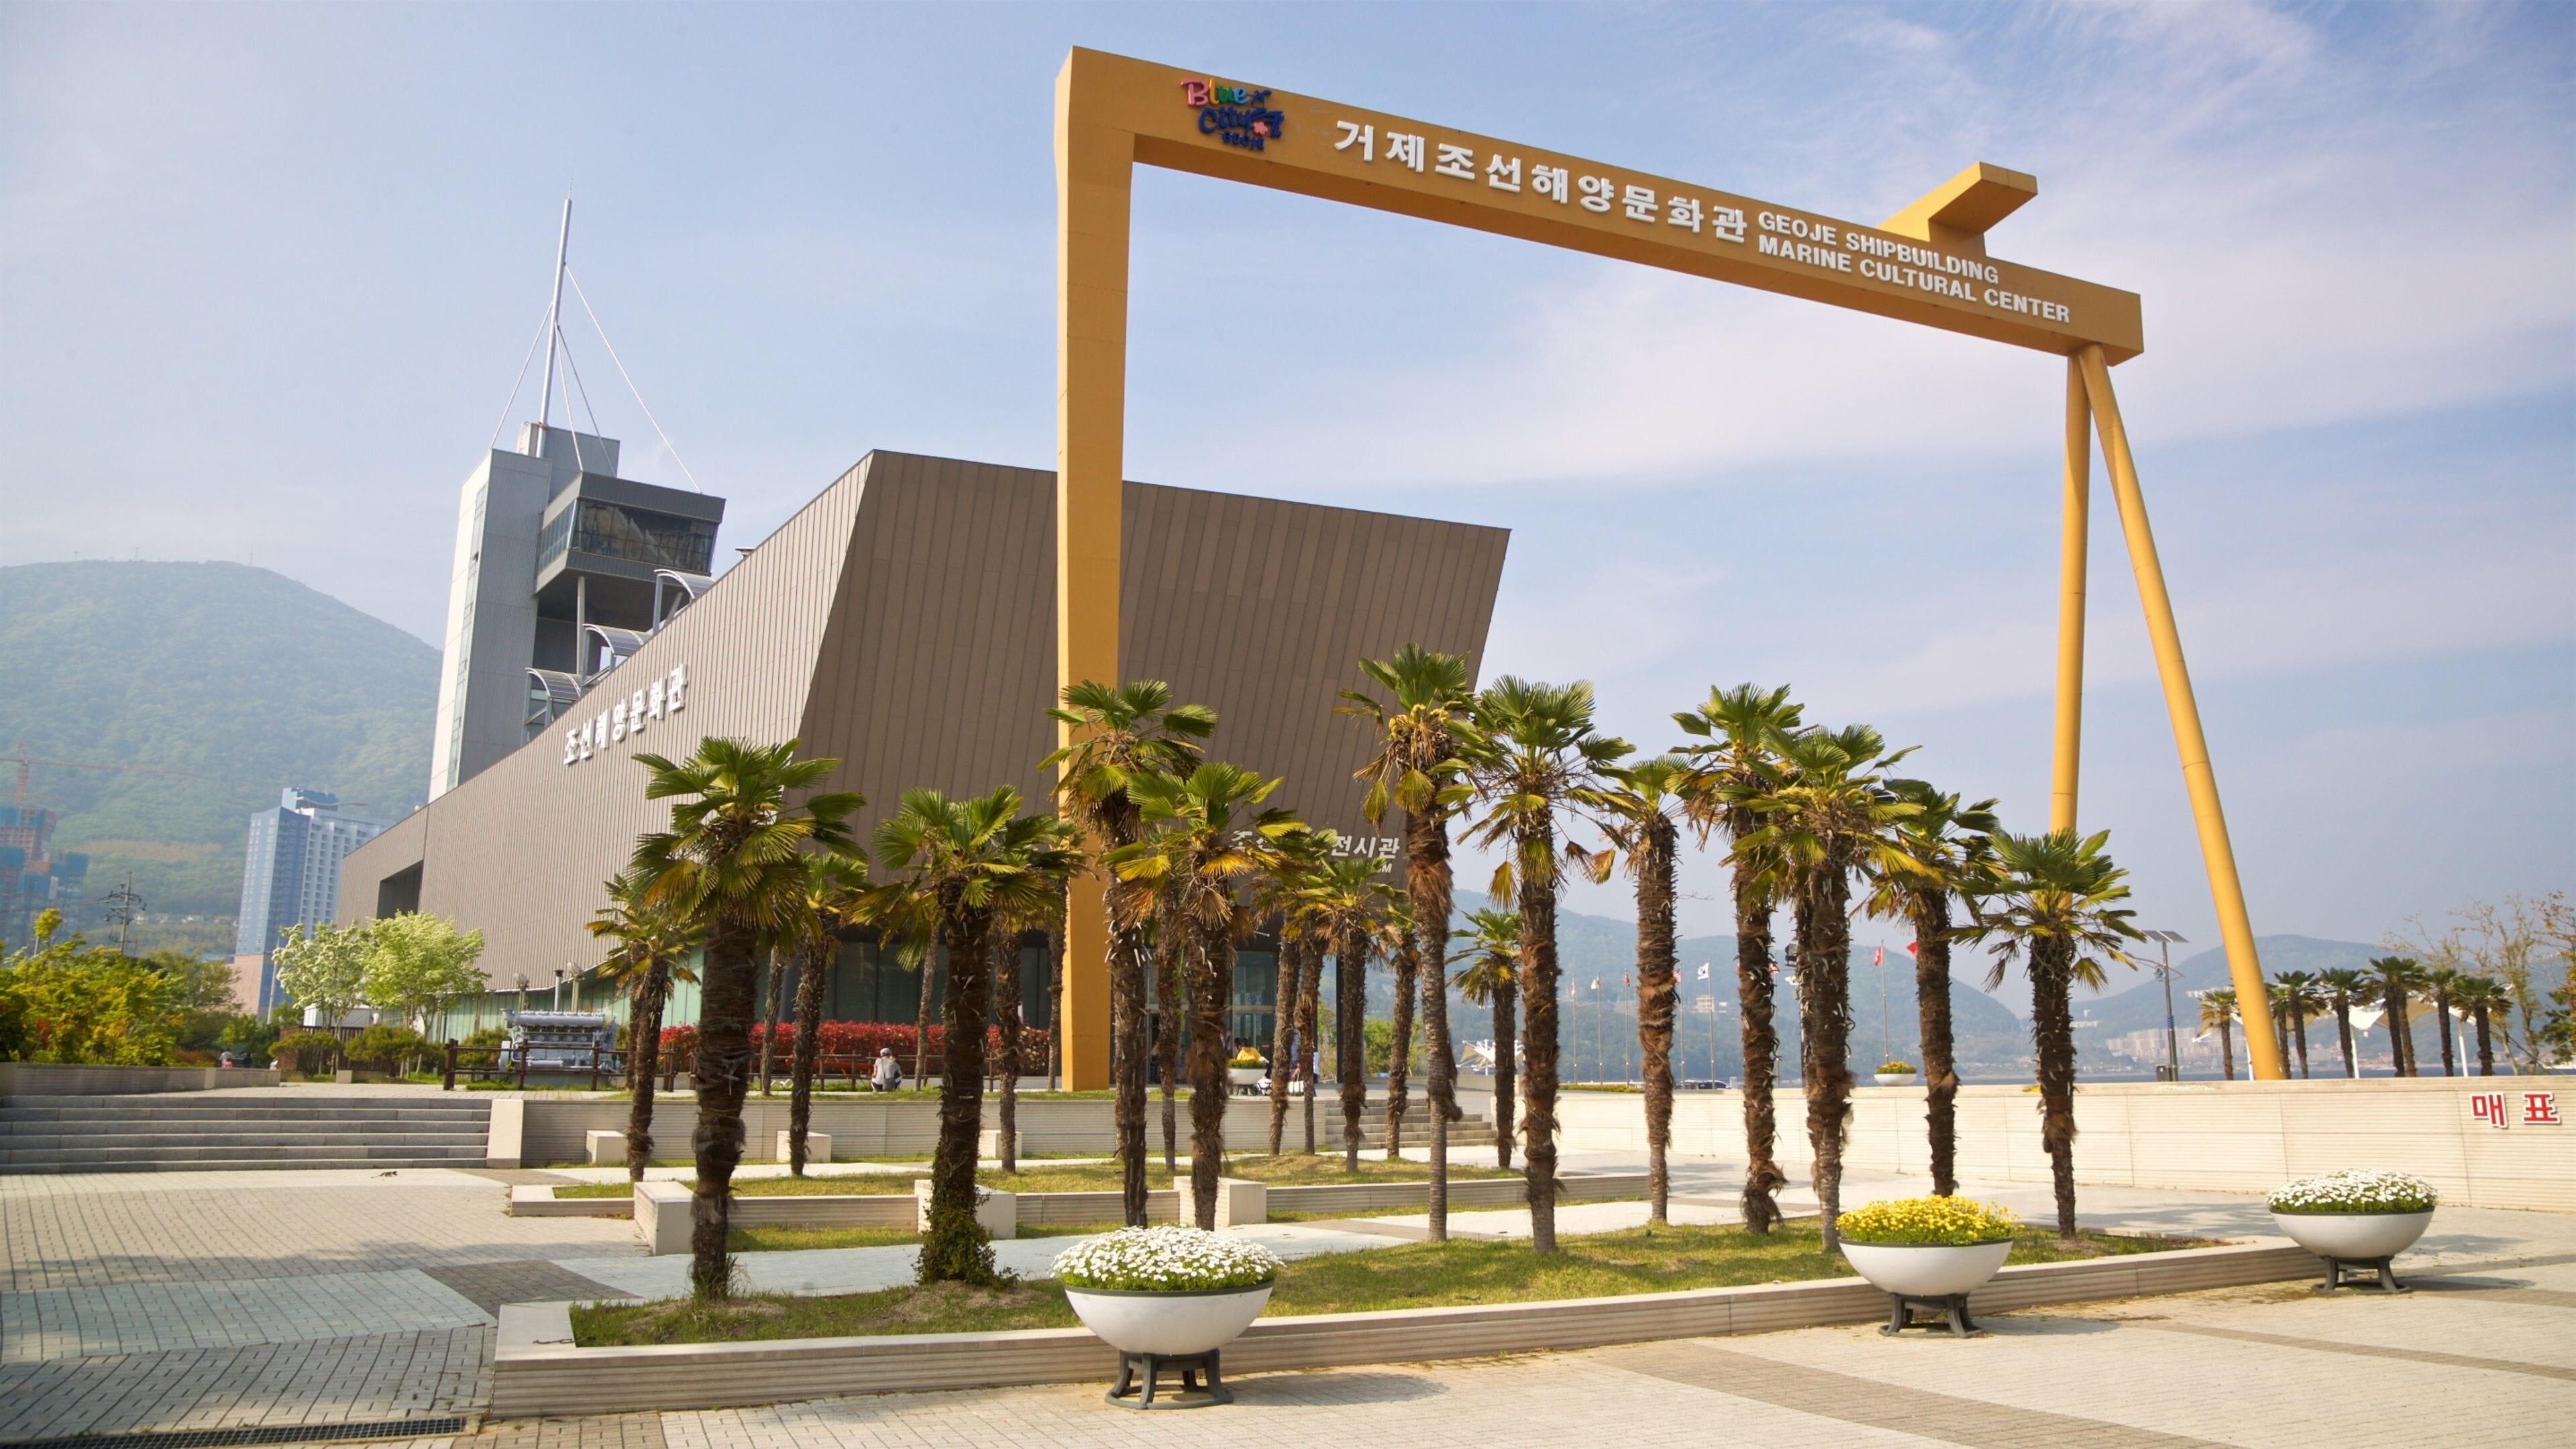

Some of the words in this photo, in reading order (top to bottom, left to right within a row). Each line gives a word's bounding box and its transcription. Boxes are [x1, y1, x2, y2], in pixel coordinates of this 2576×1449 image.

[1181, 77, 1250, 106] Blue
[1198, 106, 1253, 134] City
[1334, 120, 1748, 244] 거제조선해양문화관
[1758, 211, 1837, 246] GEOJE
[1845, 232, 1999, 284] SHIPBUILDING
[1758, 234, 1851, 273] MARINE
[1860, 258, 1977, 302] CULTURAL
[1984, 288, 2070, 323] CENTER
[563, 663, 688, 765] 조선해양문화관
